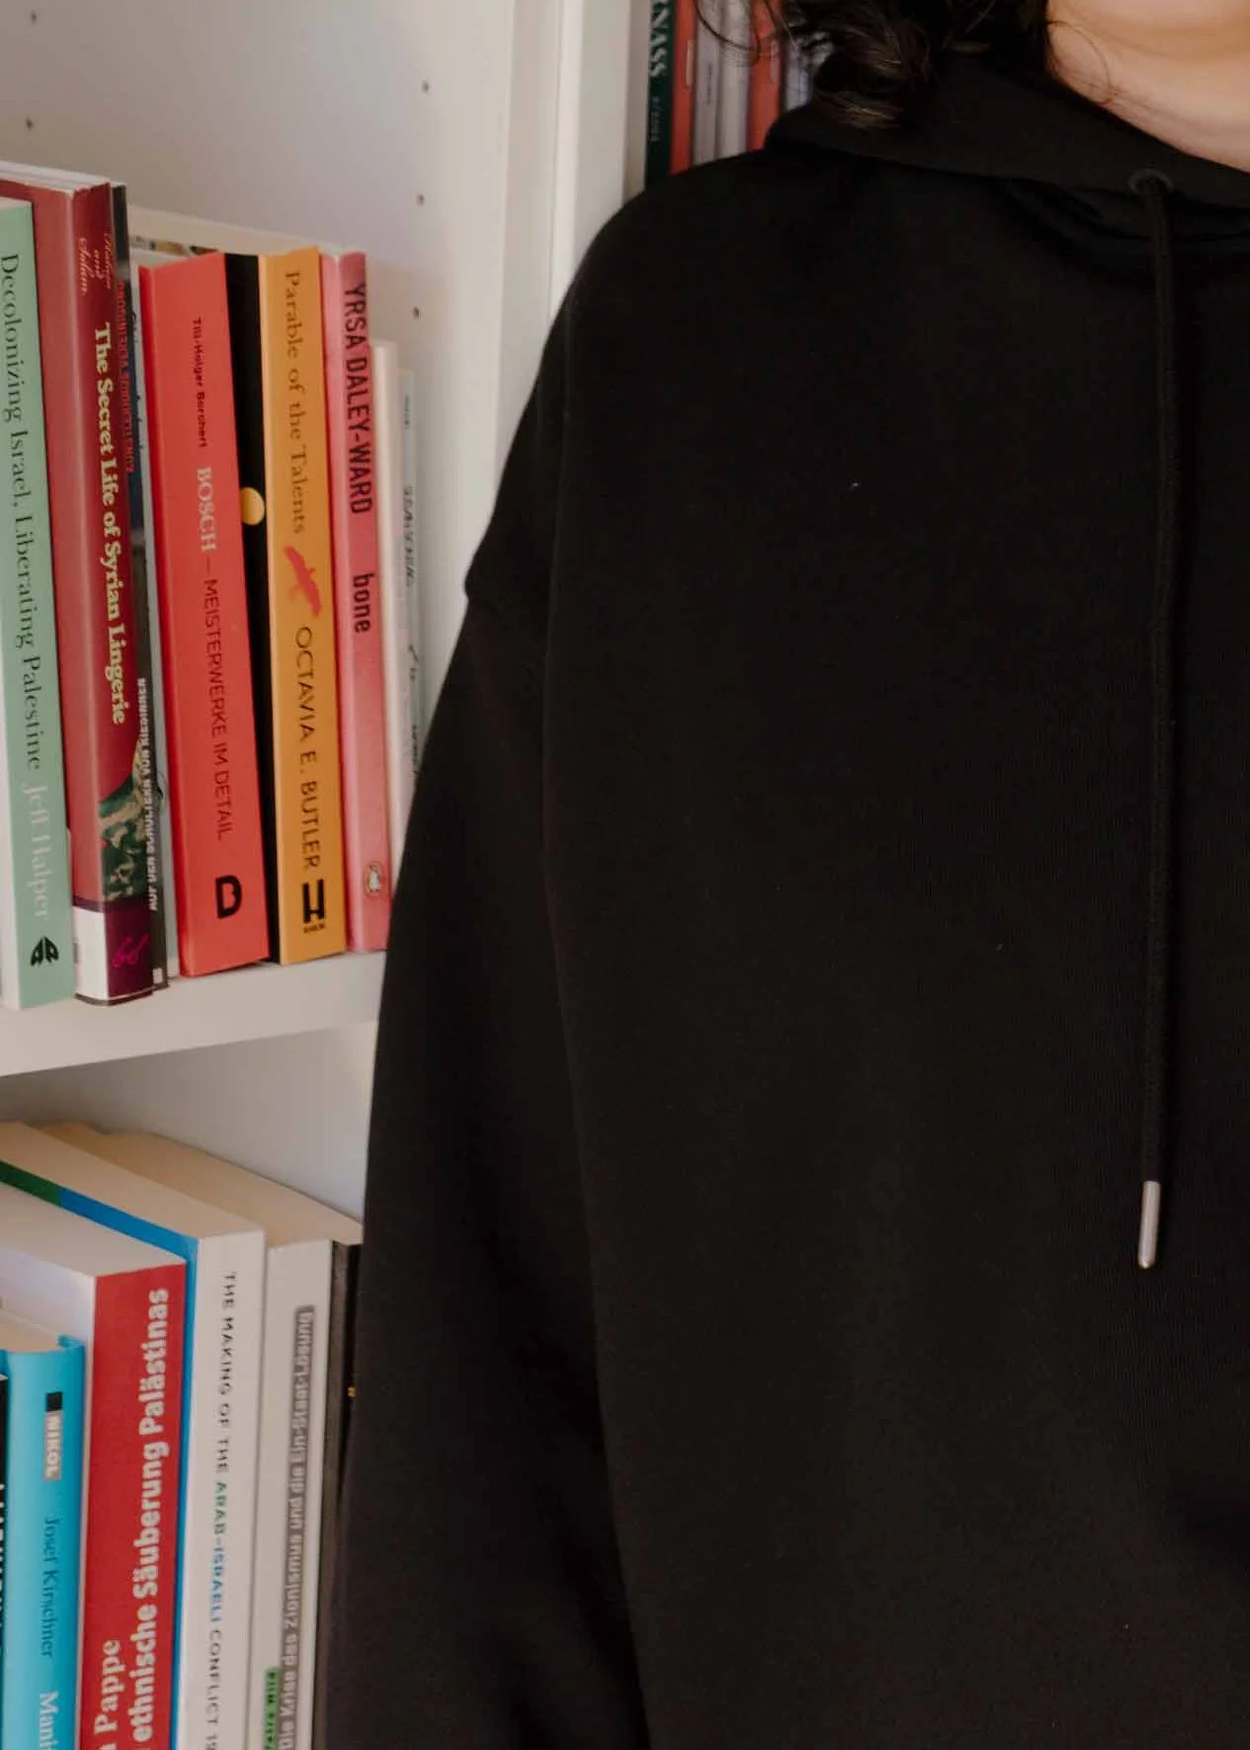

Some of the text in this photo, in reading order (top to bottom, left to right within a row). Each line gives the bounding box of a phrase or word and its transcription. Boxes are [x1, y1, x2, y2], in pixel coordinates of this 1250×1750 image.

[284, 271, 308, 535] Parable of the Talents
[343, 283, 373, 514] YRSA DALEY-WARD
[94, 322, 128, 725] The Secret Life of Syrian Lingerie
[196, 467, 216, 553] BOSCH
[0, 253, 53, 922] Decolonizing Israel, Liberating Palestine Jeff Halper
[352, 573, 376, 633] bone
[203, 578, 228, 740] MEISTERWERKE
[212, 742, 230, 767] IM
[213, 770, 235, 841] DETAIL
[295, 626, 321, 868] OCTAVIA E. BUTLER
[43, 1414, 63, 1478] NIKOL
[206, 1272, 237, 1726] THE MAKING OF THE ARAB-ISRAELI CONFLICT
[288, 1467, 306, 1494] die
[129, 1288, 170, 1743] ethnische Säuberung Palästinas
[286, 1496, 303, 1530] und
[38, 1515, 62, 1750] Josef Kirschner Mani
[283, 1535, 303, 1630] Zionismus
[94, 1639, 125, 1734] Pappe
